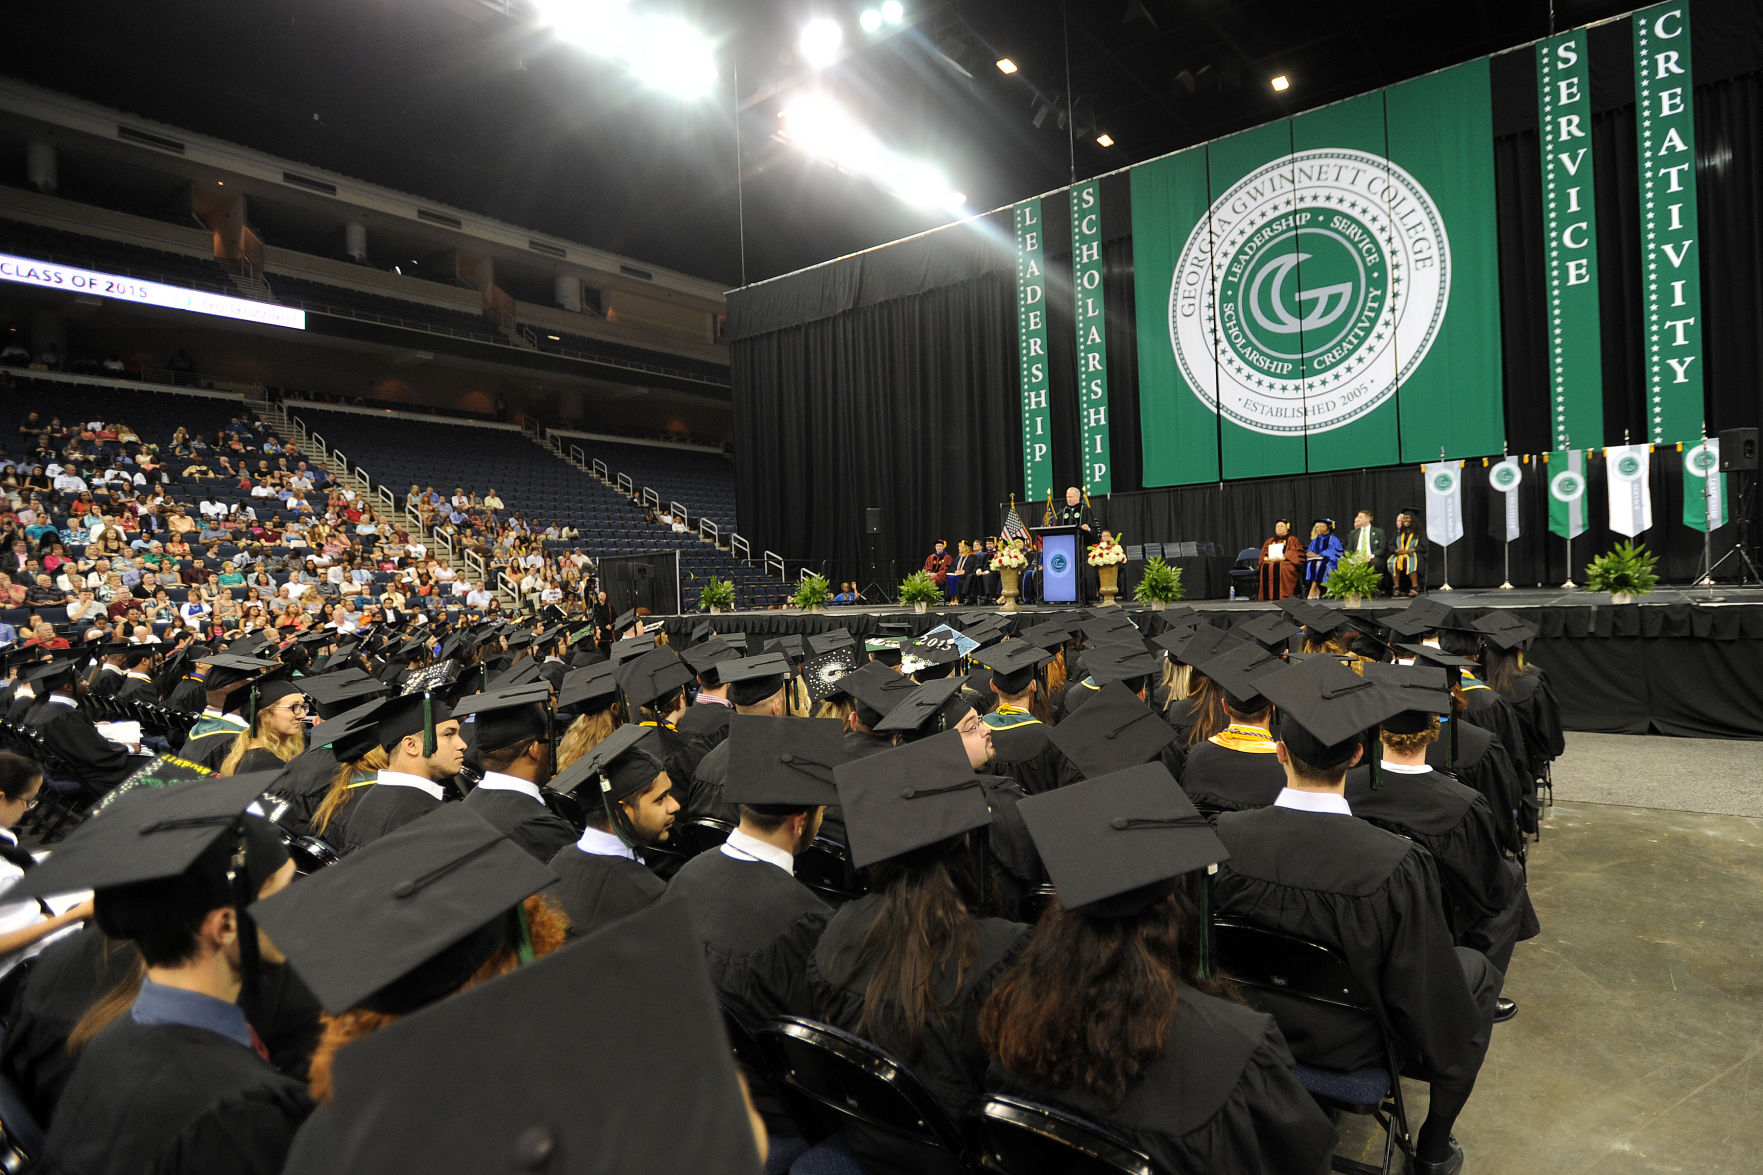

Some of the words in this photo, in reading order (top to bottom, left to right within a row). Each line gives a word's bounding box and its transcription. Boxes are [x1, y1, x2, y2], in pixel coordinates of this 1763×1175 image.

[1556, 40, 1591, 287] SERVICE
[1653, 9, 1696, 385] CREATIVITY
[0, 261, 63, 284] CLASS
[71, 275, 97, 290] OF
[105, 281, 148, 298] 2015
[1181, 216, 1232, 318] GEORGIA
[1231, 164, 1367, 216] GWINNETT
[1367, 176, 1434, 271] COLLEGE
[1227, 212, 1311, 283] LEADERSHIP
[1330, 215, 1380, 267] SERVICE
[1023, 206, 1048, 463] LEADERSHIP
[1079, 186, 1107, 483] SCHOLARSHIP
[1222, 302, 1293, 375] SCHOLARSHIP
[1312, 286, 1382, 370] CREATIVITY
[1243, 398, 1337, 419] ESTABLISHED
[1340, 384, 1369, 407] 2005
